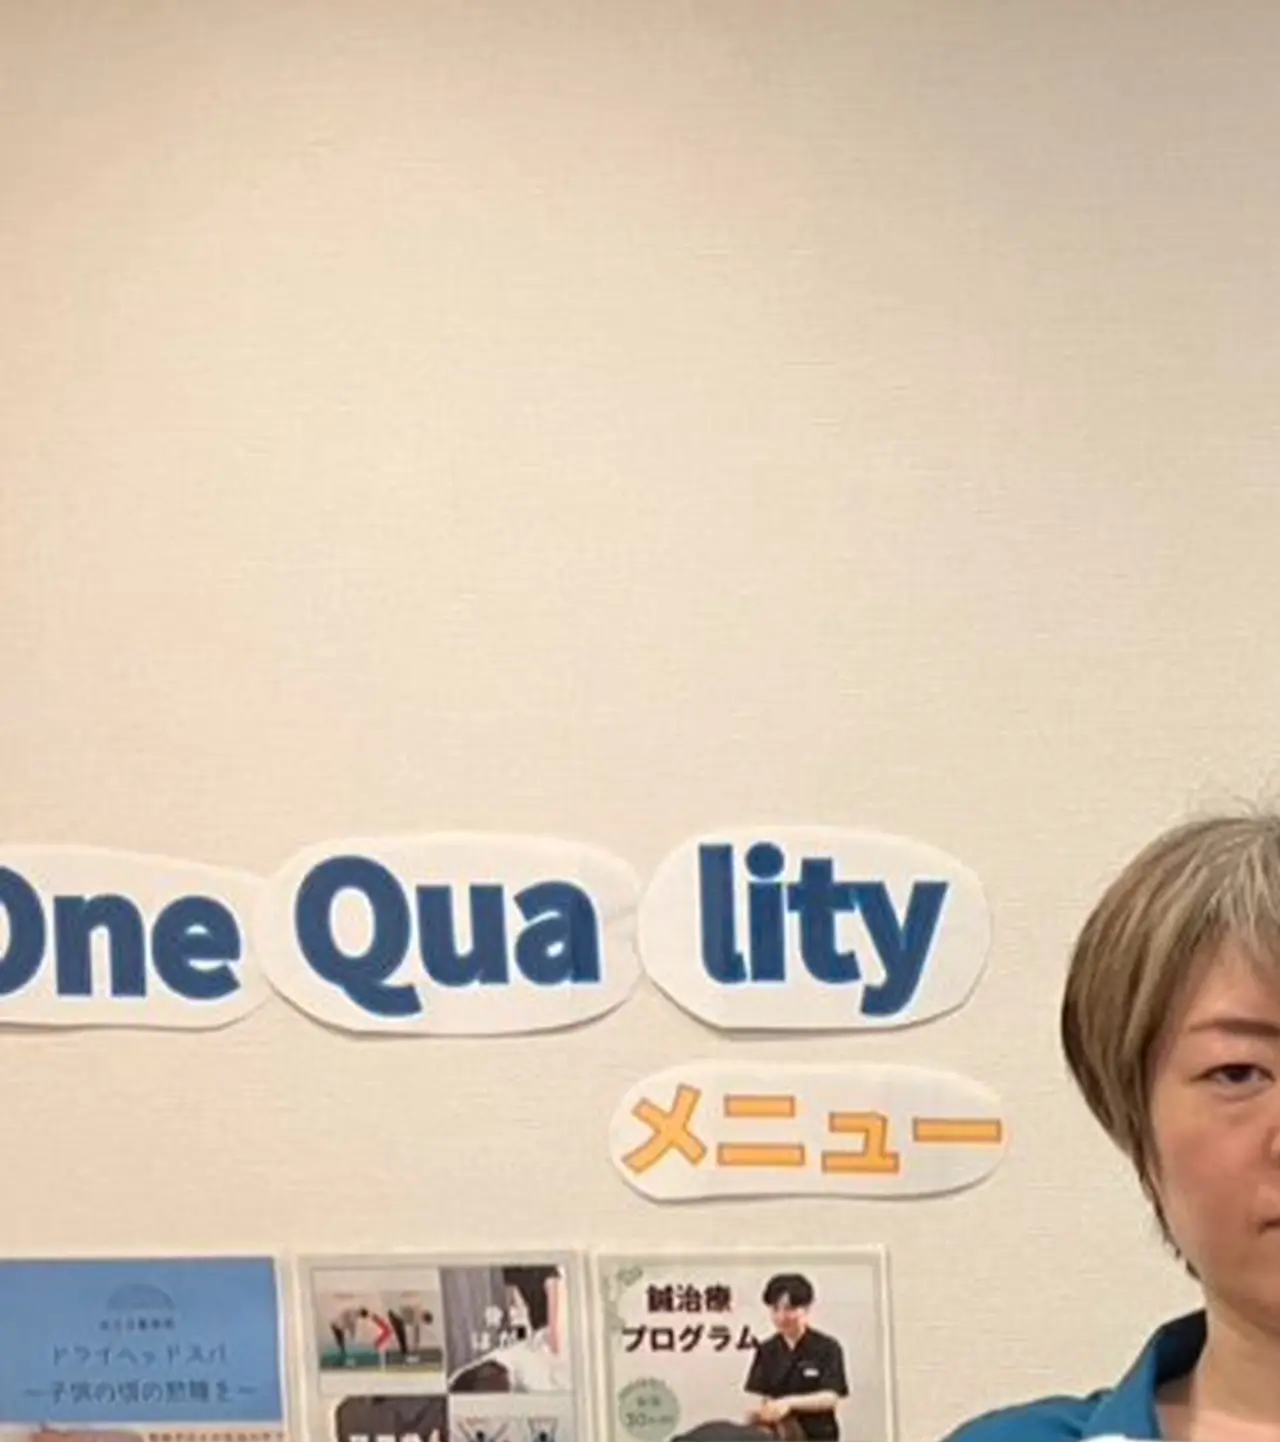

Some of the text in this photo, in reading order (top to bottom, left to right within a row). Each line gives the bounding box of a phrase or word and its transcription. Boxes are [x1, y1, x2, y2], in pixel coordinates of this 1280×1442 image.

[622, 1083, 1003, 1174] メニュー
[647, 1284, 731, 1312] 鍼治療
[622, 1324, 760, 1352] プログラム
[52, 1343, 228, 1366] ドライヘッドスパ
